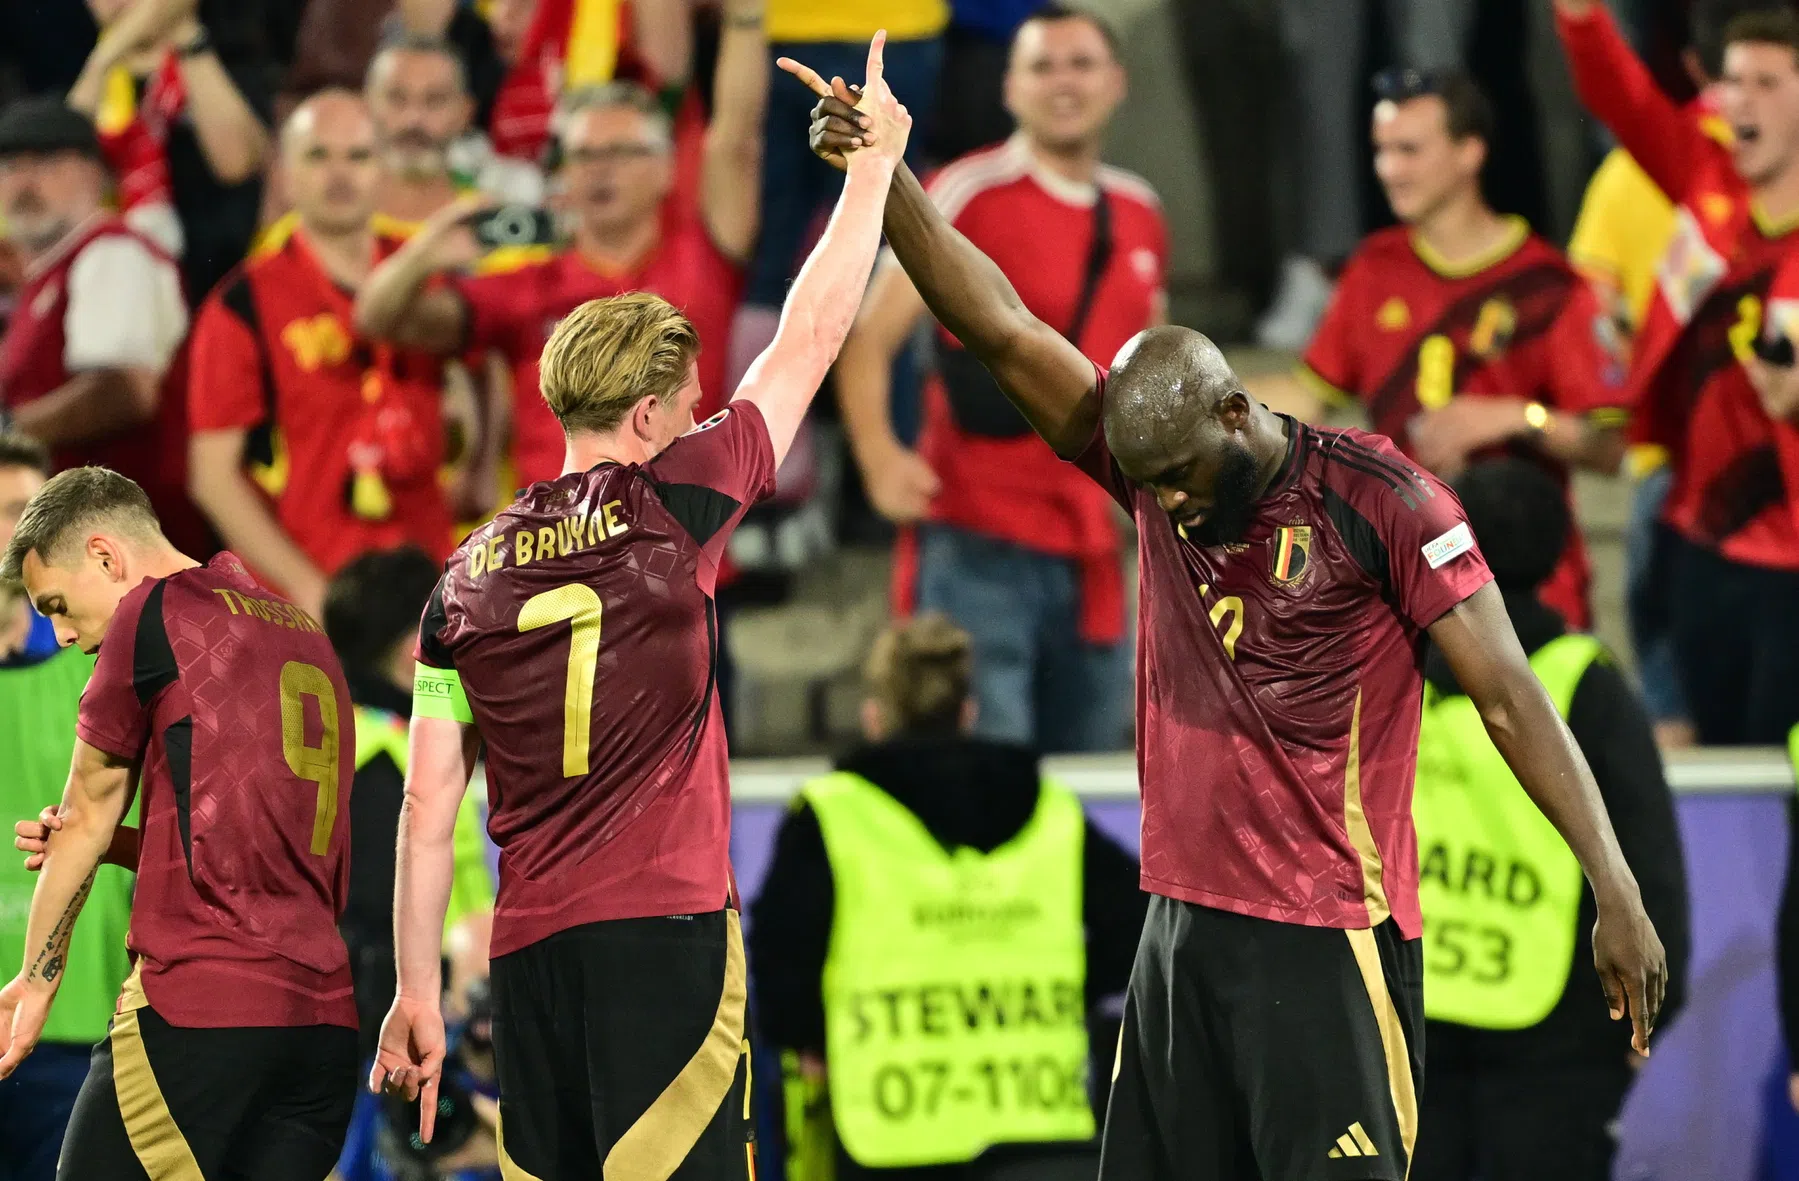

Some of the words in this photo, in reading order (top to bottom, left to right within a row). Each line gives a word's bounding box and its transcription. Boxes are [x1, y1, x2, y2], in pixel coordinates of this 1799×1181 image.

[470, 534, 505, 579] DE
[515, 499, 629, 566] BRUYNE
[517, 582, 603, 778] 7
[279, 660, 340, 856] 9
[1419, 841, 1543, 908] ARD
[1422, 916, 1511, 984] 53
[852, 977, 1083, 1045] STEWAR
